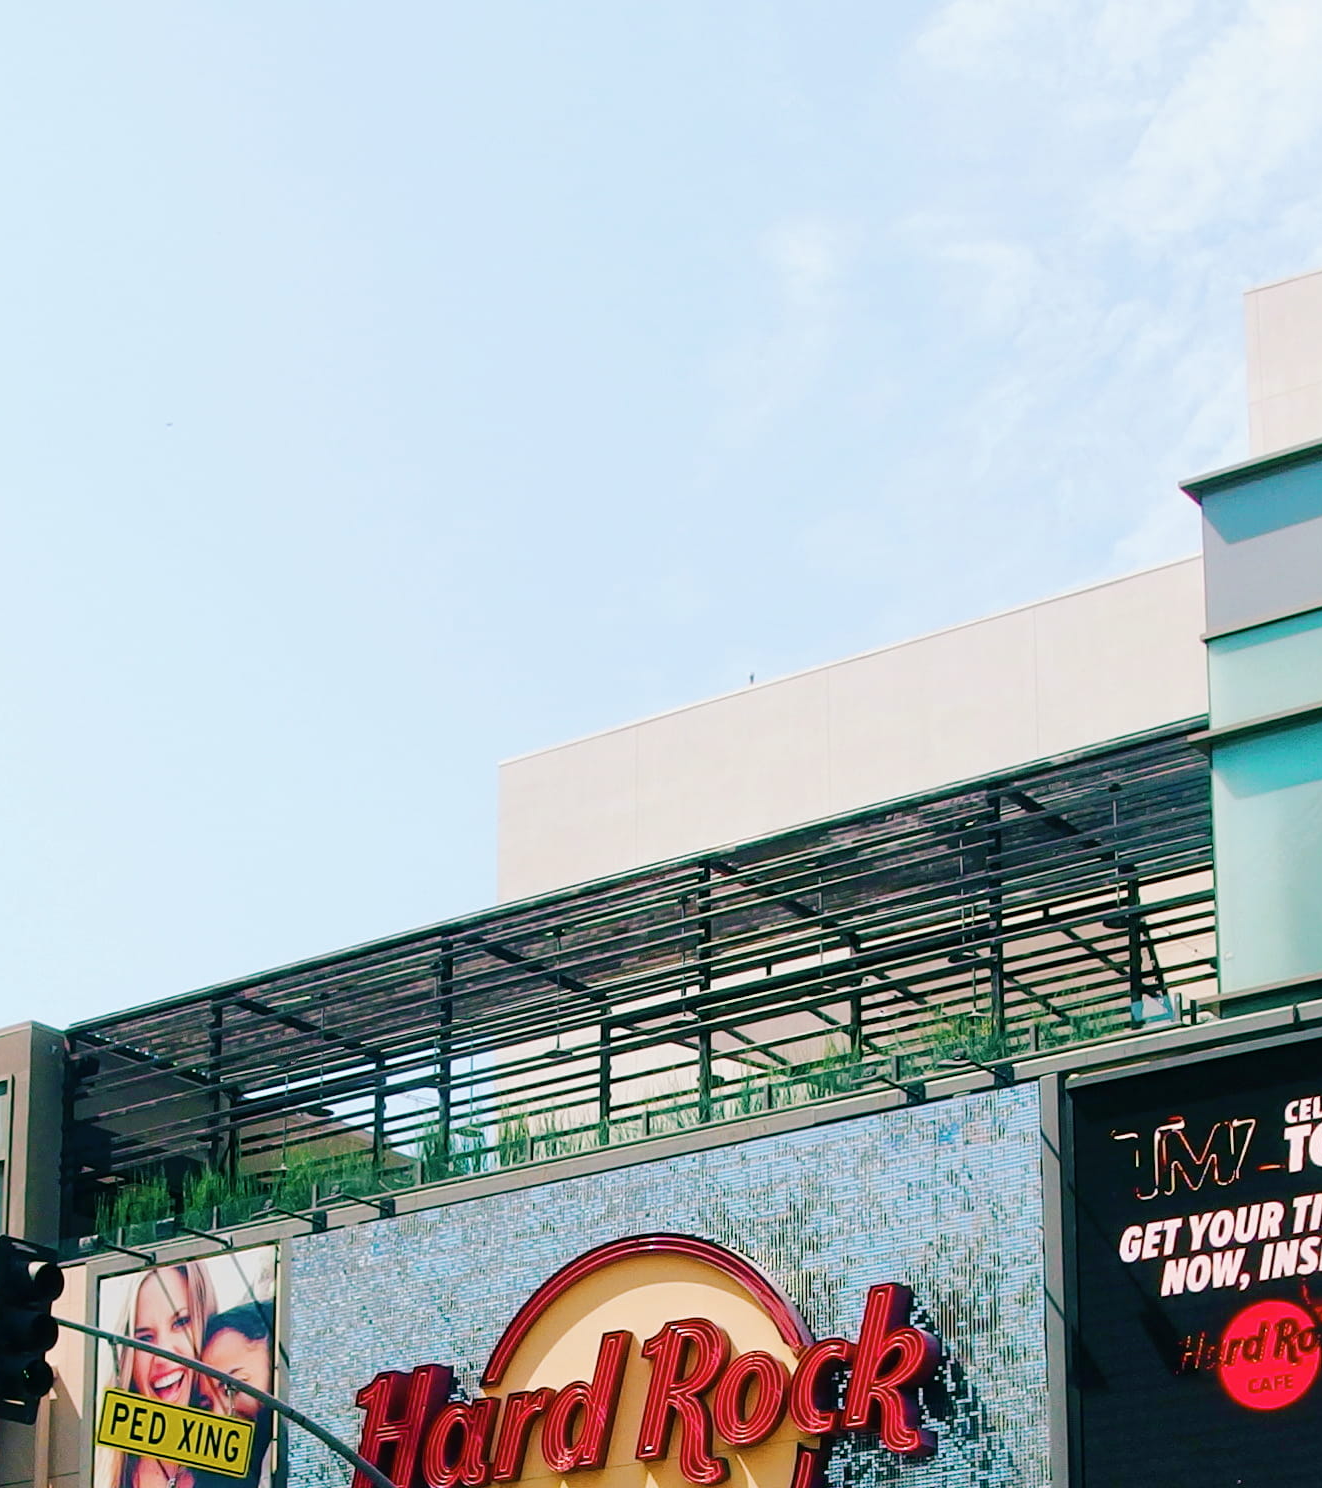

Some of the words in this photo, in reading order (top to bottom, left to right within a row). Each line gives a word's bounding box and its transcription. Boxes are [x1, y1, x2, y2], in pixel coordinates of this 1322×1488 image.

[1118, 1216, 1182, 1263] GET
[1188, 1200, 1285, 1251] YOUR
[1160, 1247, 1251, 1297] NOW,
[635, 1281, 942, 1487] Rock
[1247, 1373, 1294, 1394] CAFE
[110, 1402, 167, 1445] PED
[177, 1418, 241, 1463] XING
